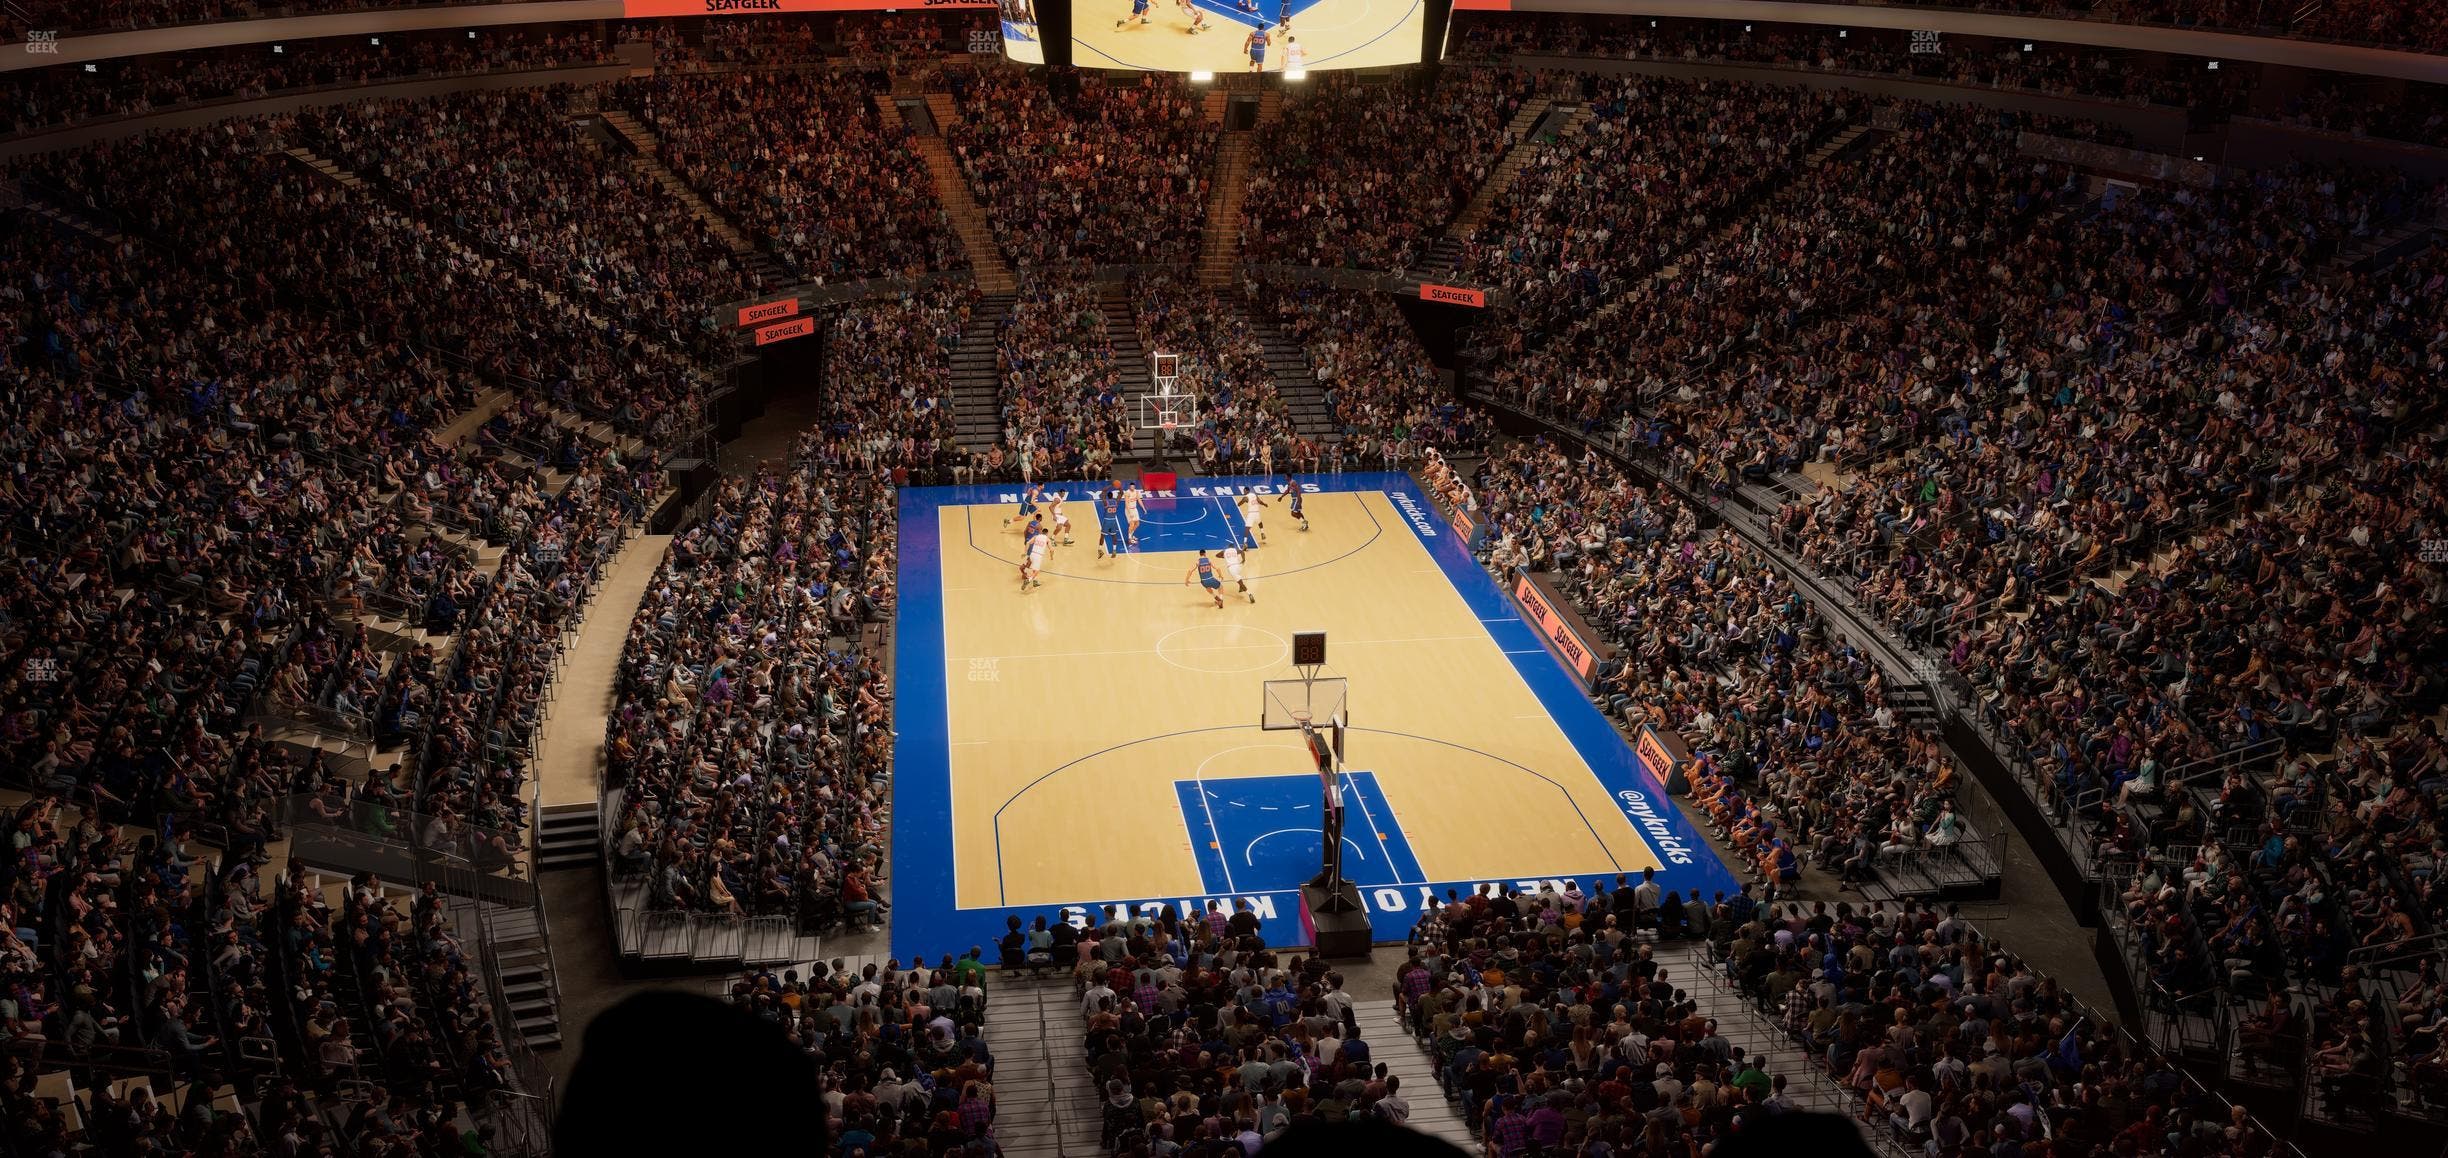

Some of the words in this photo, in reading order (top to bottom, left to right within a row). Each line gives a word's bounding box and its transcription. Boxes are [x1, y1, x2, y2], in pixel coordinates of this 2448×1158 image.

[706, 0, 780, 11] SEATGEEK
[1432, 289, 1474, 303] SEATGEEK
[749, 304, 788, 320] SEATGEEK
[765, 324, 803, 340] SEATGEEK
[1521, 586, 1548, 624] SEATGEEK
[1554, 625, 1584, 667] SEATGEEK
[1640, 737, 1669, 781] SEATGEEK
[1618, 790, 1693, 864] @nyknicks
[1277, 1000, 1290, 1014] 00
